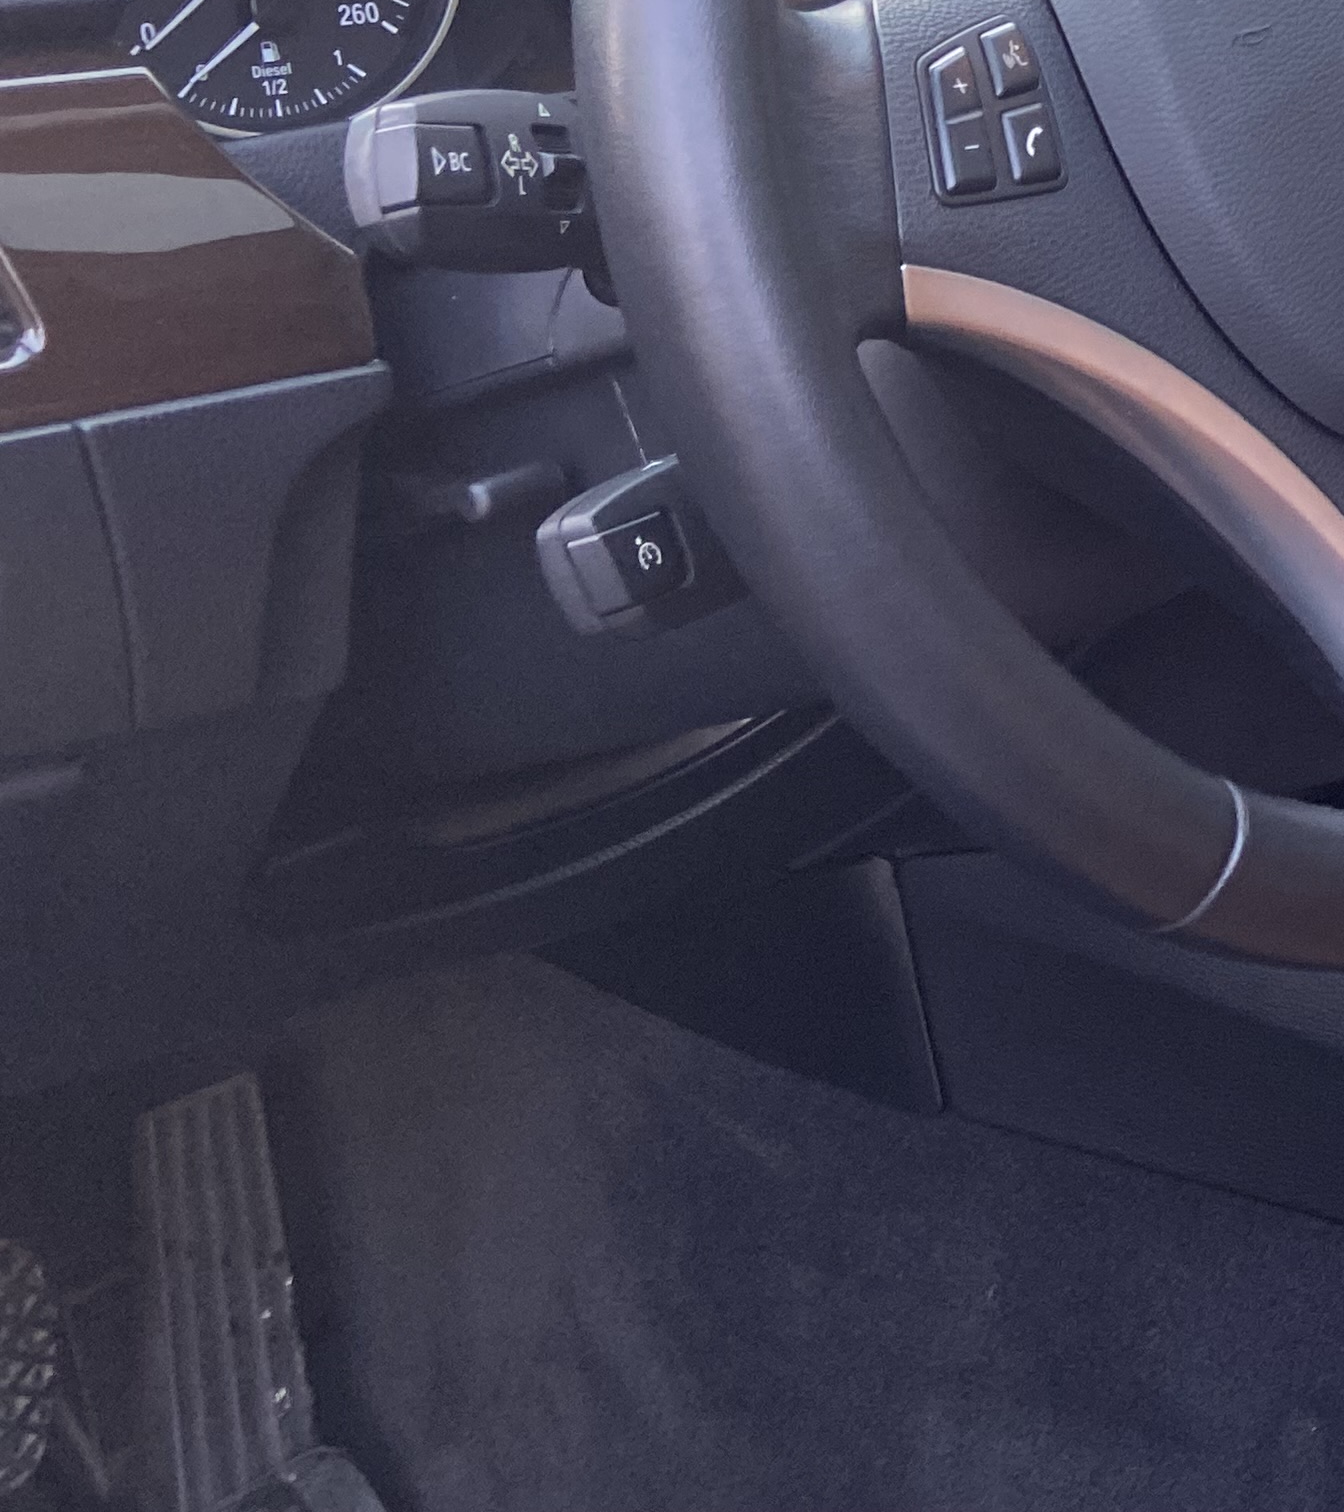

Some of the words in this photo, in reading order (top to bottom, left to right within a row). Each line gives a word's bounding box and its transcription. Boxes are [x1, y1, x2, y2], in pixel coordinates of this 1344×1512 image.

[337, 1, 380, 26] 260
[332, 49, 344, 65] 1
[251, 62, 292, 79] Diesel
[262, 79, 288, 96] 1/2
[448, 152, 472, 172] BC
